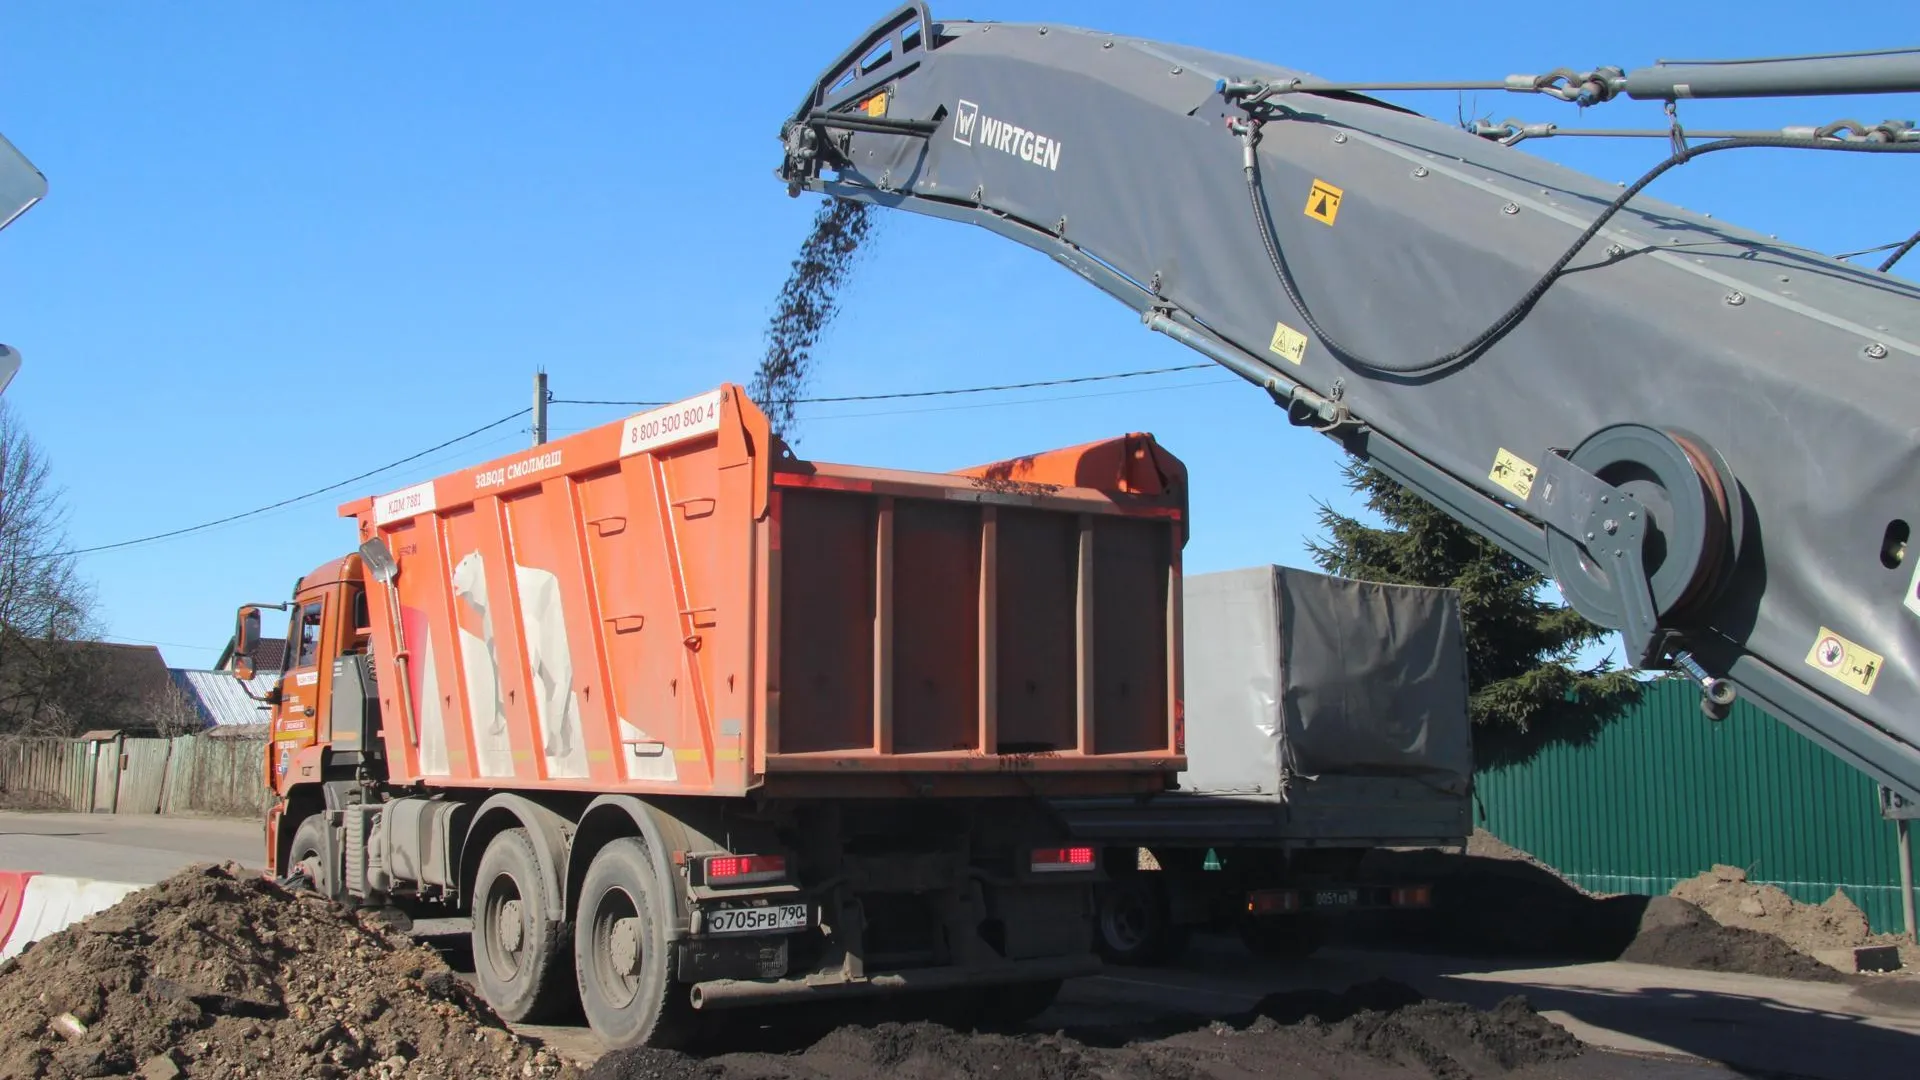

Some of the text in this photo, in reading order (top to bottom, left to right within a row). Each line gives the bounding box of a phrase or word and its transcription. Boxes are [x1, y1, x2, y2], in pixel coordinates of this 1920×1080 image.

[980, 115, 1061, 171] WIRTGEN
[631, 402, 714, 444] 8 800 500 800 4
[475, 450, 562, 489] завод смолмаш
[388, 498, 405, 515] КДМ
[781, 905, 804, 921] 790
